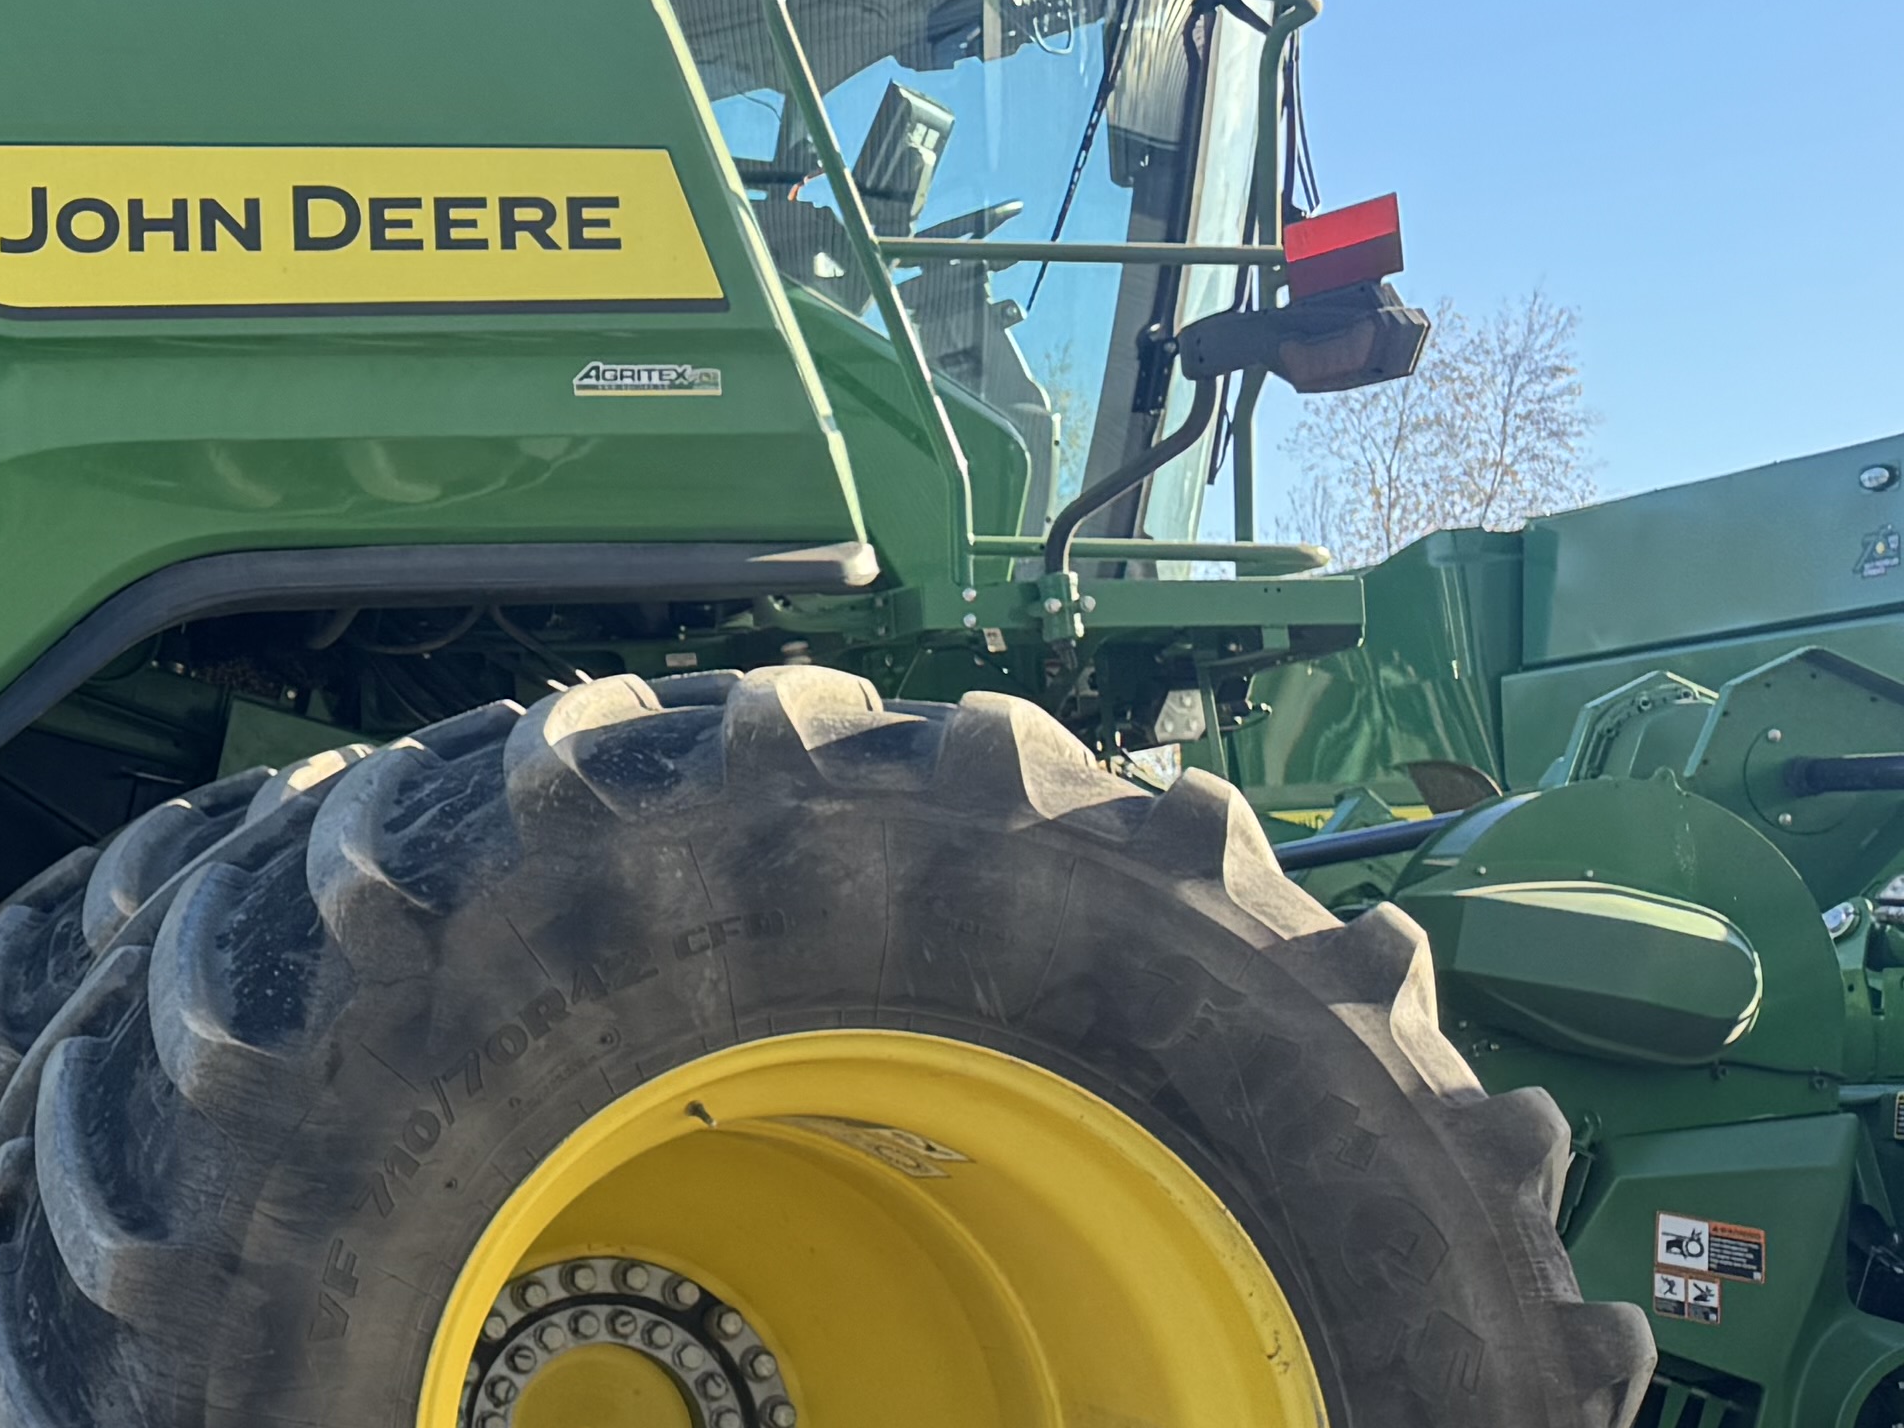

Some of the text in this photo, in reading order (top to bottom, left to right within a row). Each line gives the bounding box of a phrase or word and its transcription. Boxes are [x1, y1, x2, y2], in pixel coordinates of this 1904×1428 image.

[0, 185, 621, 254] JOHN DEERE
[579, 365, 689, 383] AGRITEX
[305, 1236, 364, 1343] VF
[352, 948, 660, 1220] 710/70R42
